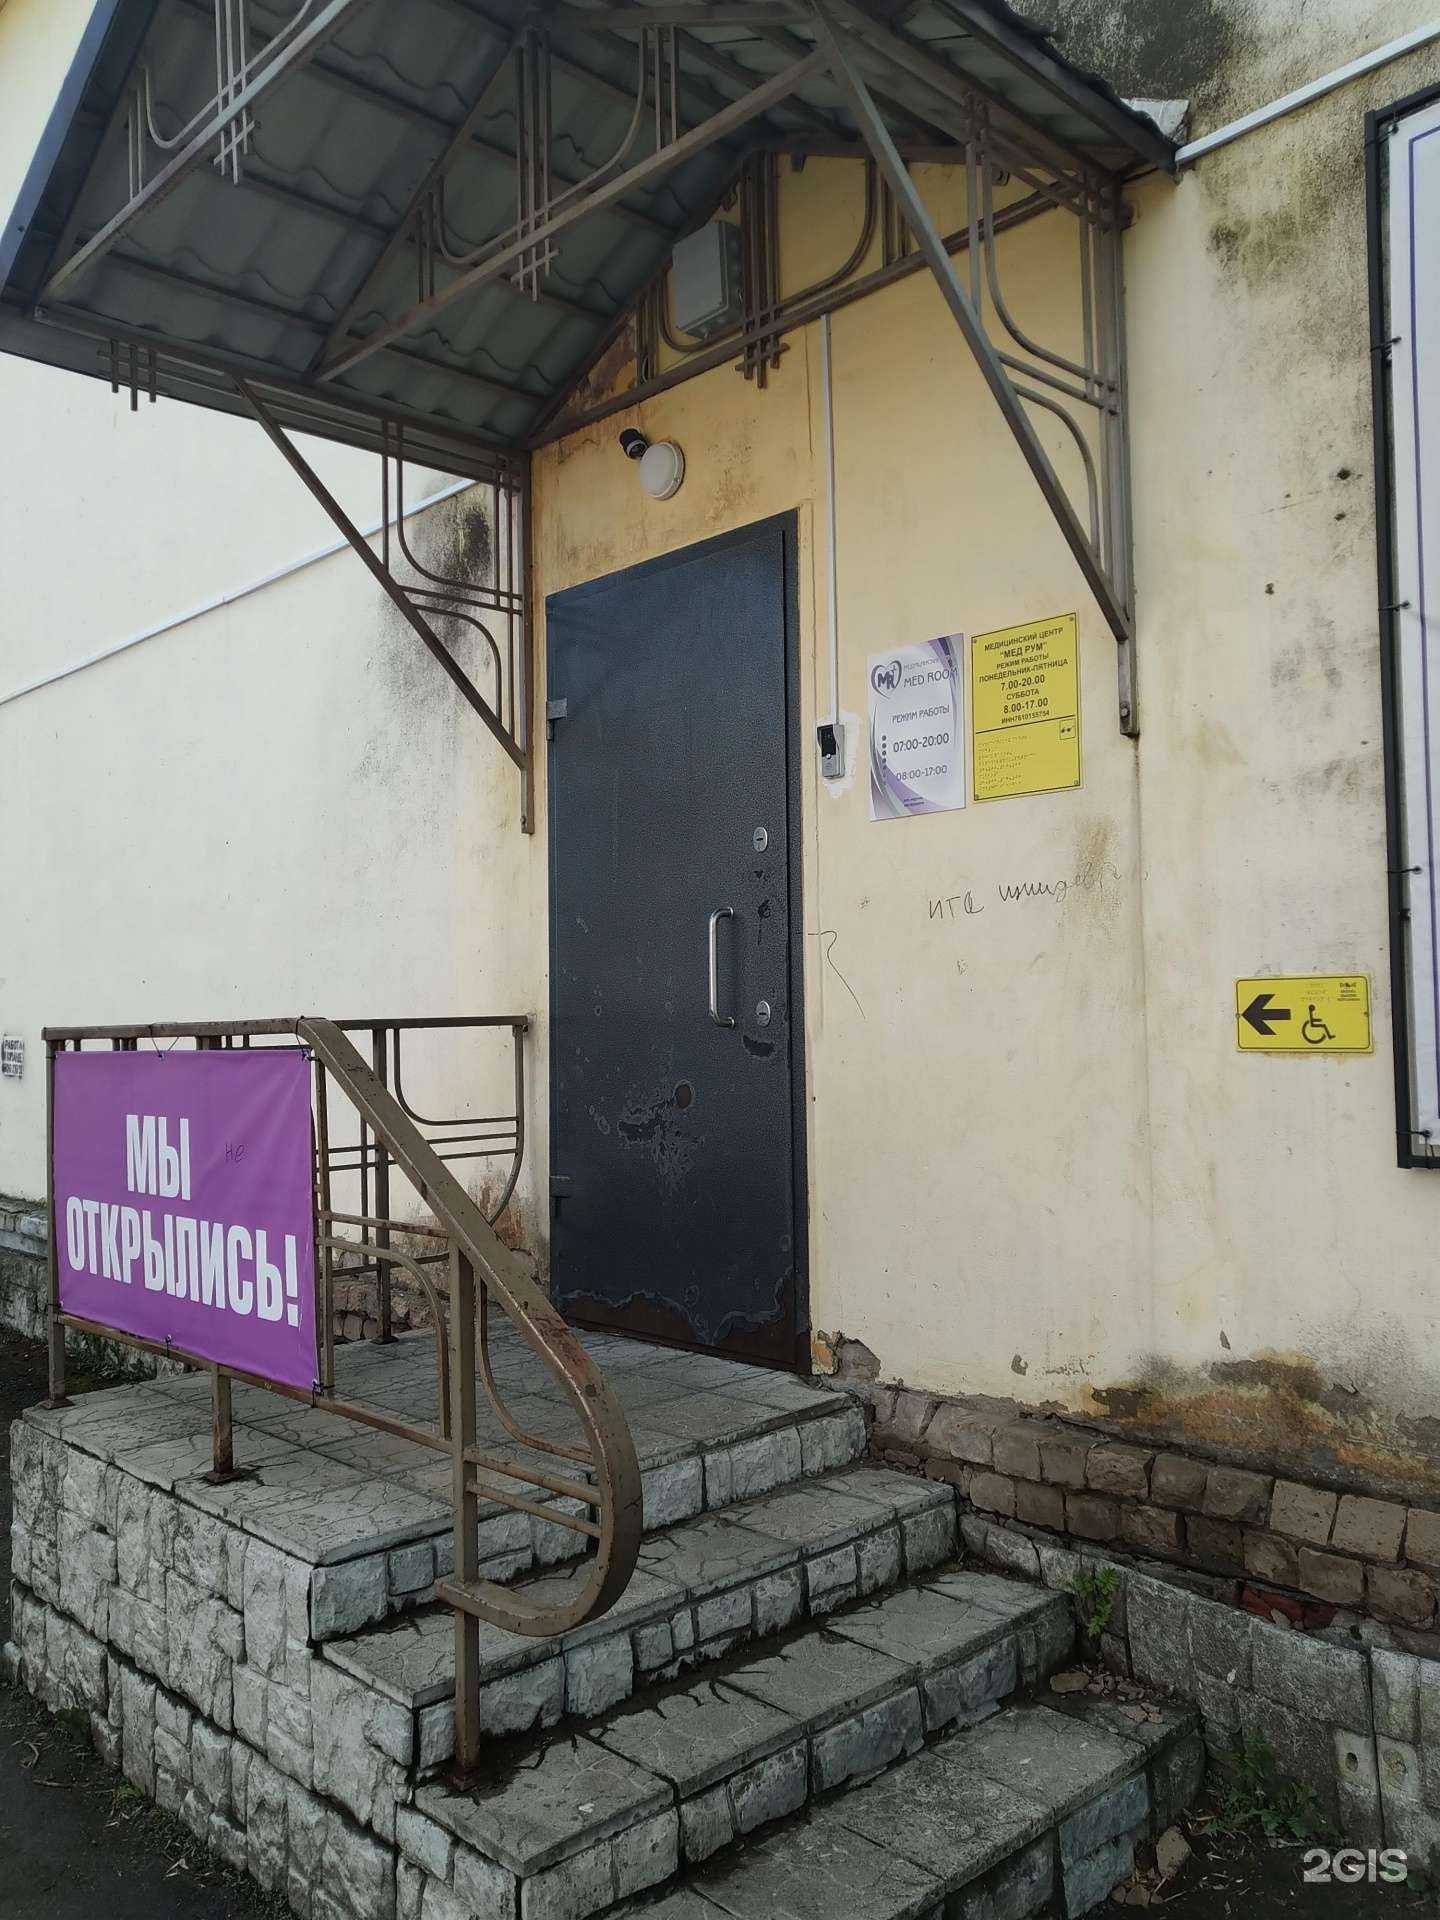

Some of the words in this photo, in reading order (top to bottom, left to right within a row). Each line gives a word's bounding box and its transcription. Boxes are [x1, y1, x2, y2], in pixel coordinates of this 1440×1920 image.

[984, 630, 1038, 652] МЕДИЦИНСКИЙ
[1038, 626, 1064, 642] ЦЕНТР
[978, 658, 1070, 684] ПОНЕДЕЛЬНИК-ПЯТНИЦА
[996, 658, 1021, 670] РЕЖИМ
[1020, 652, 1050, 664] РАБОТЫ
[903, 673, 925, 688] MED
[927, 666, 958, 684] ROOM
[1000, 674, 1046, 692] 7.00-20.00
[1005, 687, 1041, 701] СУББОТА
[891, 709, 919, 724] РЕЖИМ
[918, 704, 951, 719] РАБОТЫ
[1003, 697, 1049, 714] 8.00-17.00
[892, 732, 950, 753] 07:00-20:00
[896, 764, 948, 782] 08:00-17:00
[126, 1113, 191, 1201] МЫ
[66, 1196, 299, 1328] ОТКРЫЛИСЬ!
